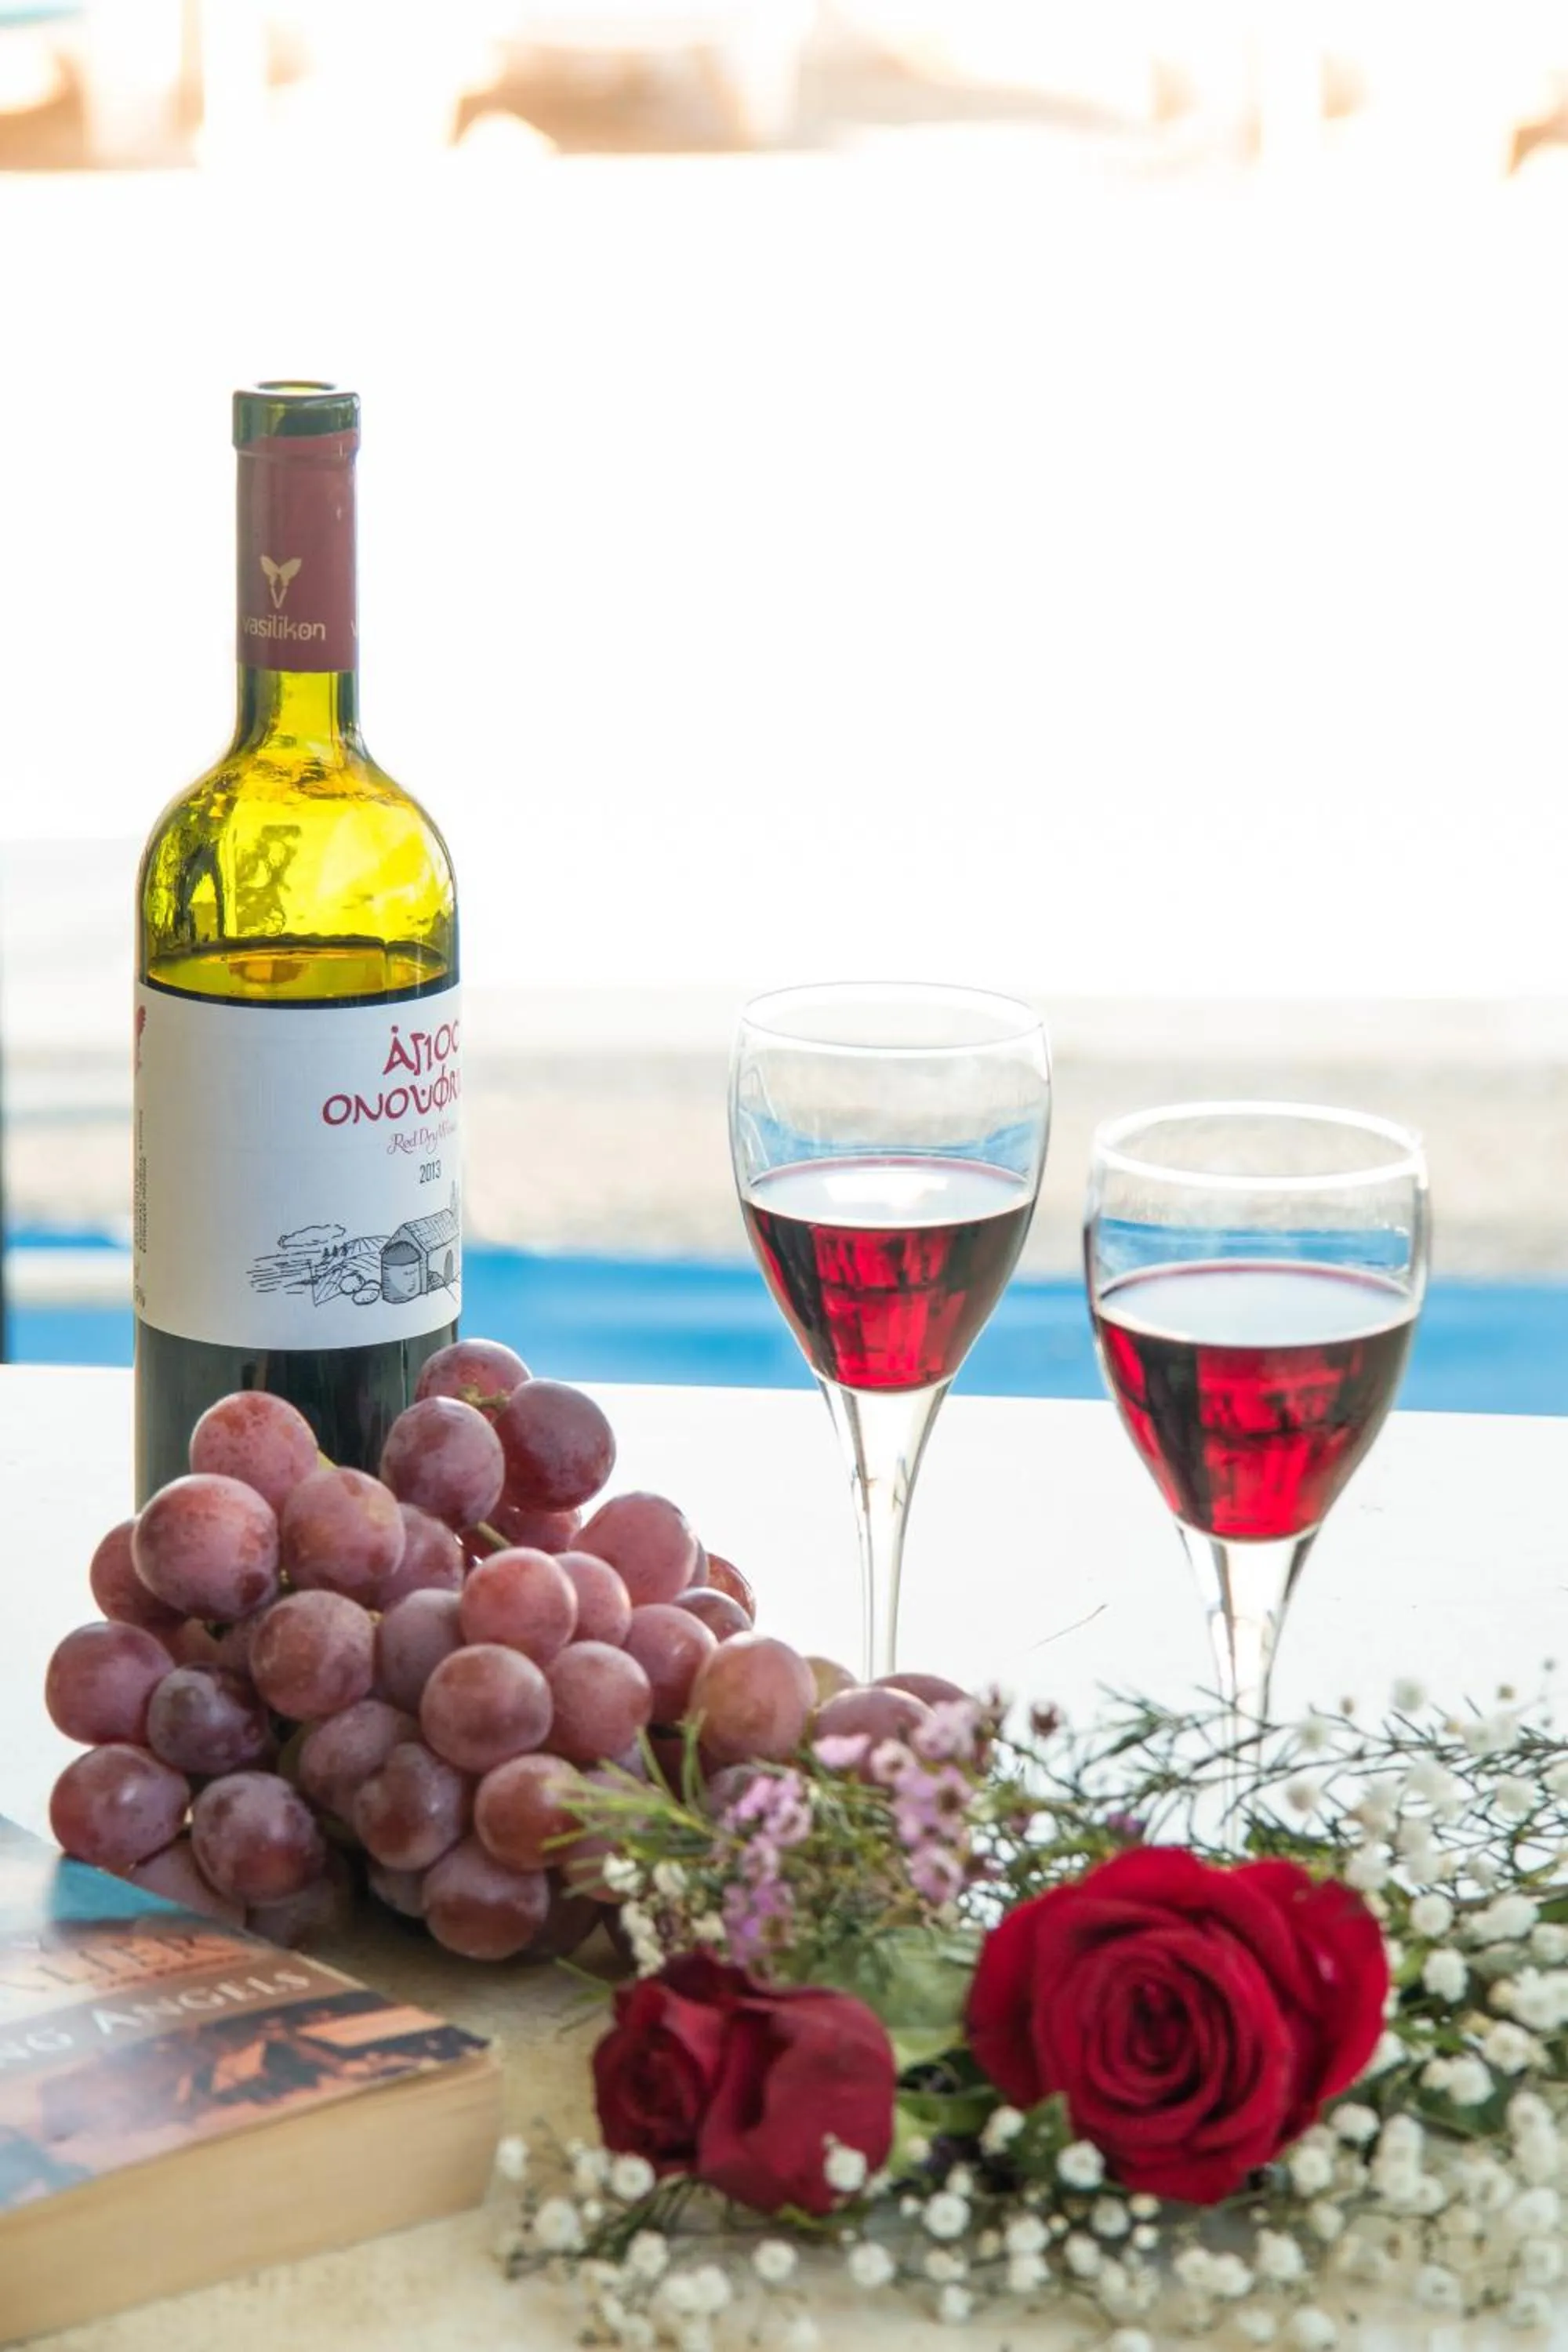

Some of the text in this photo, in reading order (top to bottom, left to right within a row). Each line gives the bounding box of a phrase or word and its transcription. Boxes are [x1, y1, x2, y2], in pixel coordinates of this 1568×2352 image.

[386, 1130, 417, 1156] Red
[419, 1160, 442, 1184] 2013
[91, 1970, 310, 2034] ANGELS
